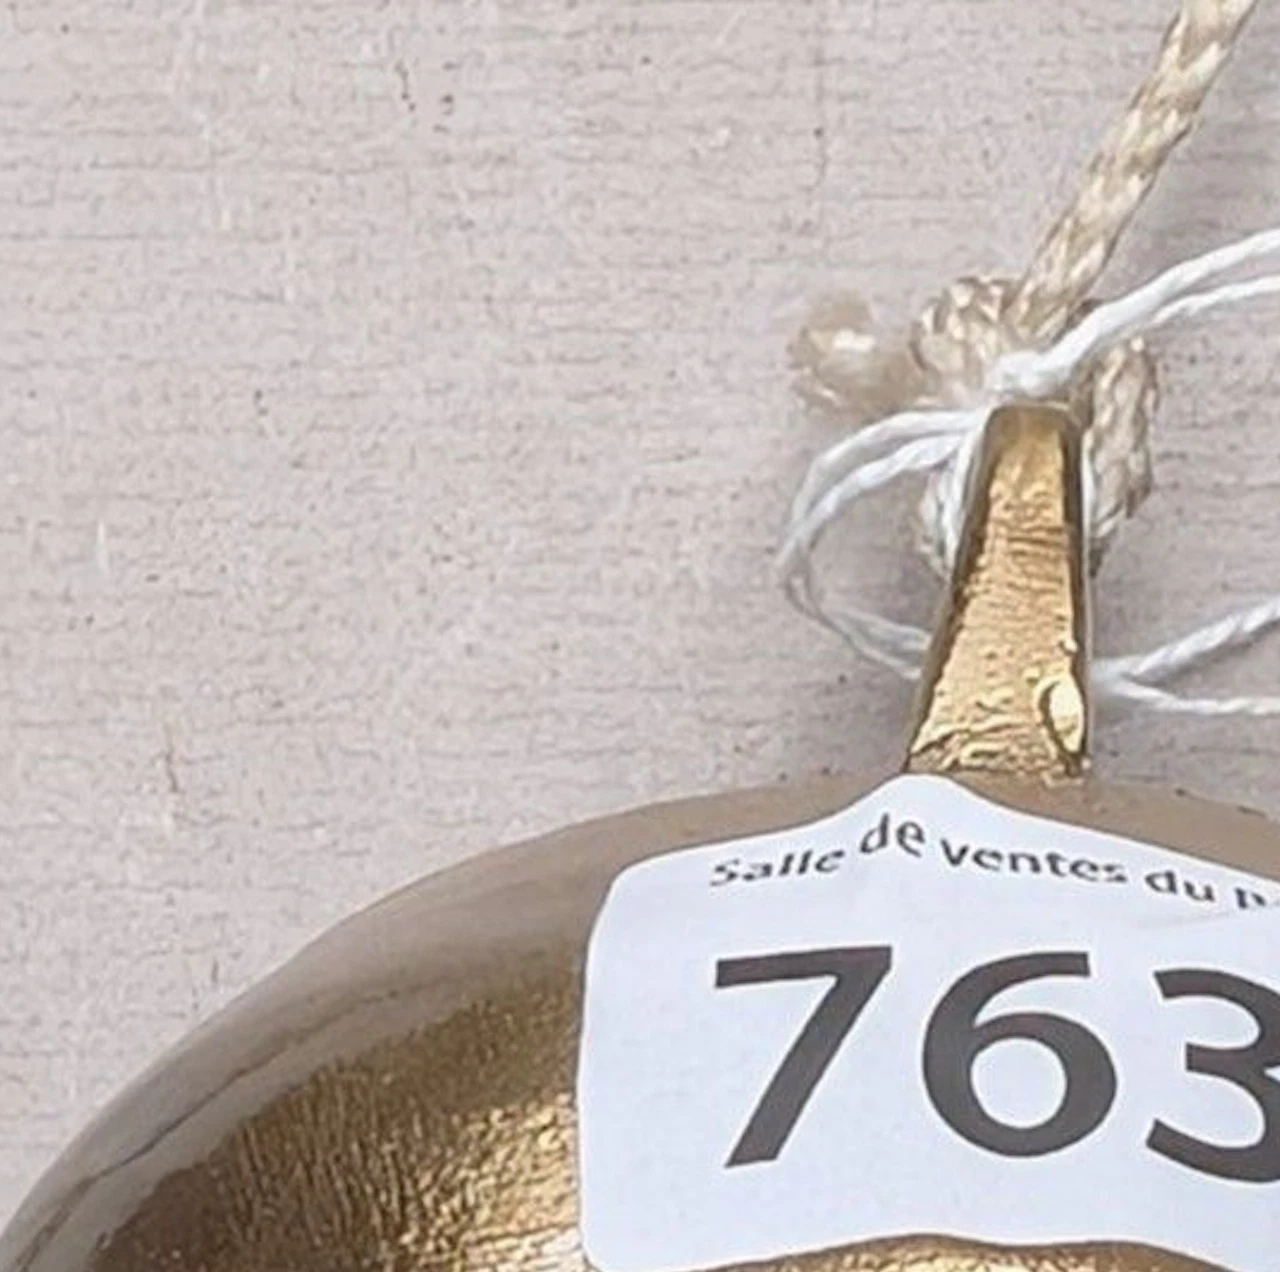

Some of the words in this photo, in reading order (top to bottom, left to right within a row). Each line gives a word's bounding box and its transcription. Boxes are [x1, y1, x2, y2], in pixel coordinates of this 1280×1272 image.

[708, 849, 845, 887] Salle
[859, 813, 925, 856] de
[940, 838, 1127, 882] ventes
[1144, 868, 1217, 903] du
